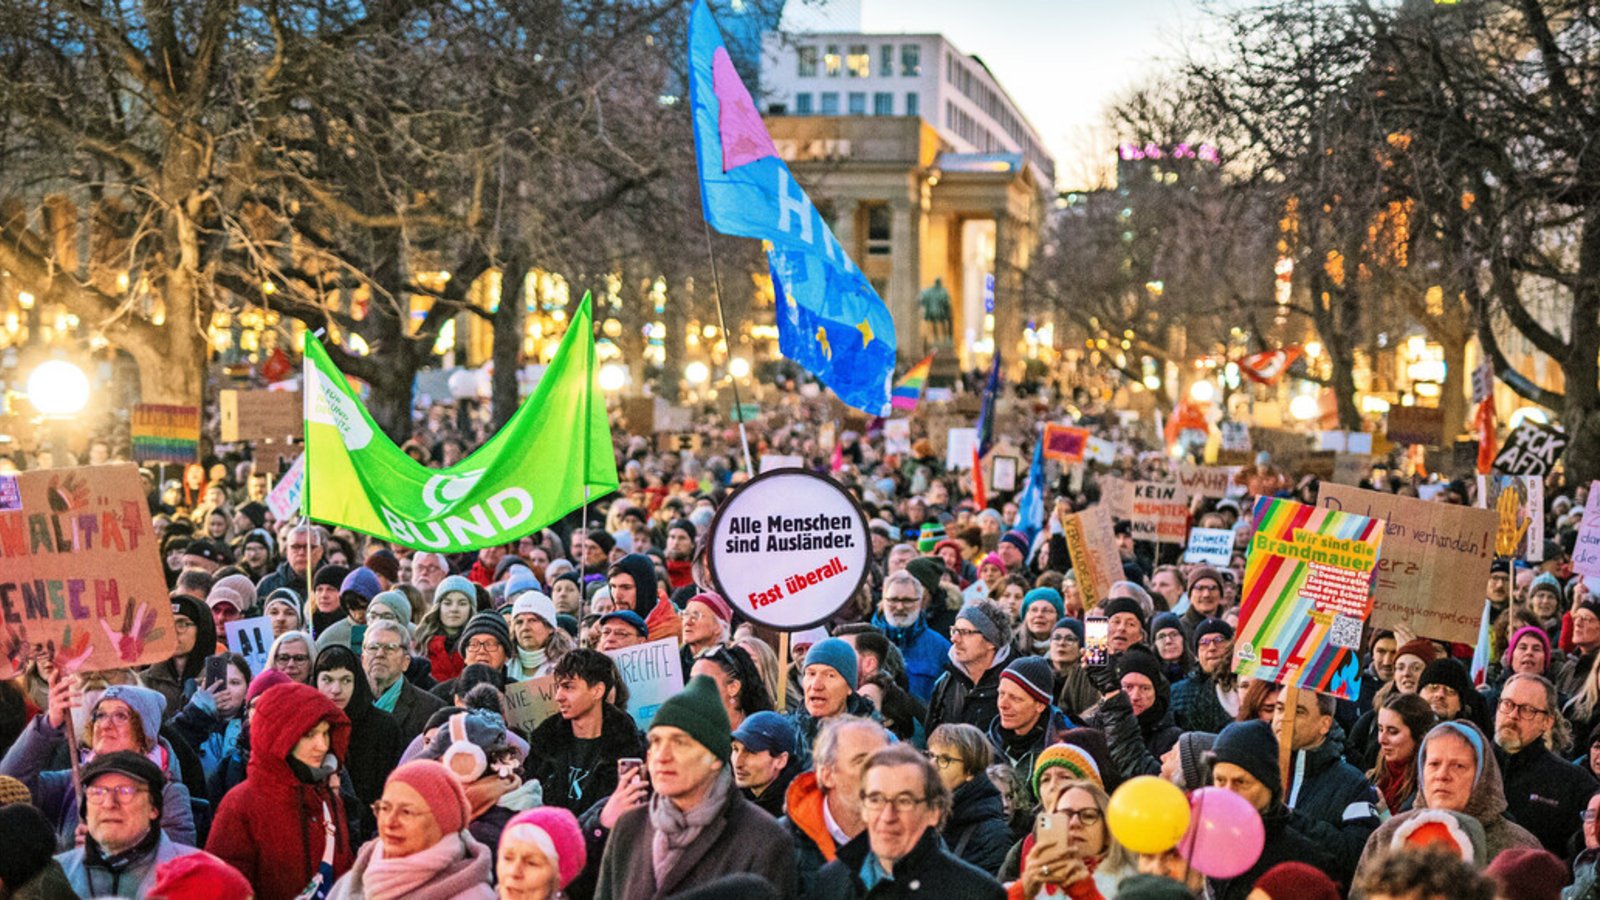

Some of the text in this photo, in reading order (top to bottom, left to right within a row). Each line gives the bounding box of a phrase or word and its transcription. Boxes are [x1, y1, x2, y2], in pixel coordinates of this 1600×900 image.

[1135, 485, 1175, 499] KEIN
[0, 497, 145, 558] NALITÄT
[381, 487, 533, 548] BUND
[729, 513, 851, 534] Alle Menschen
[726, 532, 855, 553] sind Ausländer.
[1256, 534, 1373, 571] Brandmauer
[1295, 531, 1374, 556] Wir sind die
[748, 556, 848, 610] Fast überall.
[0, 578, 120, 623] ENSCH
[1373, 600, 1481, 628] erungskompetenz
[506, 689, 531, 710] NIE
